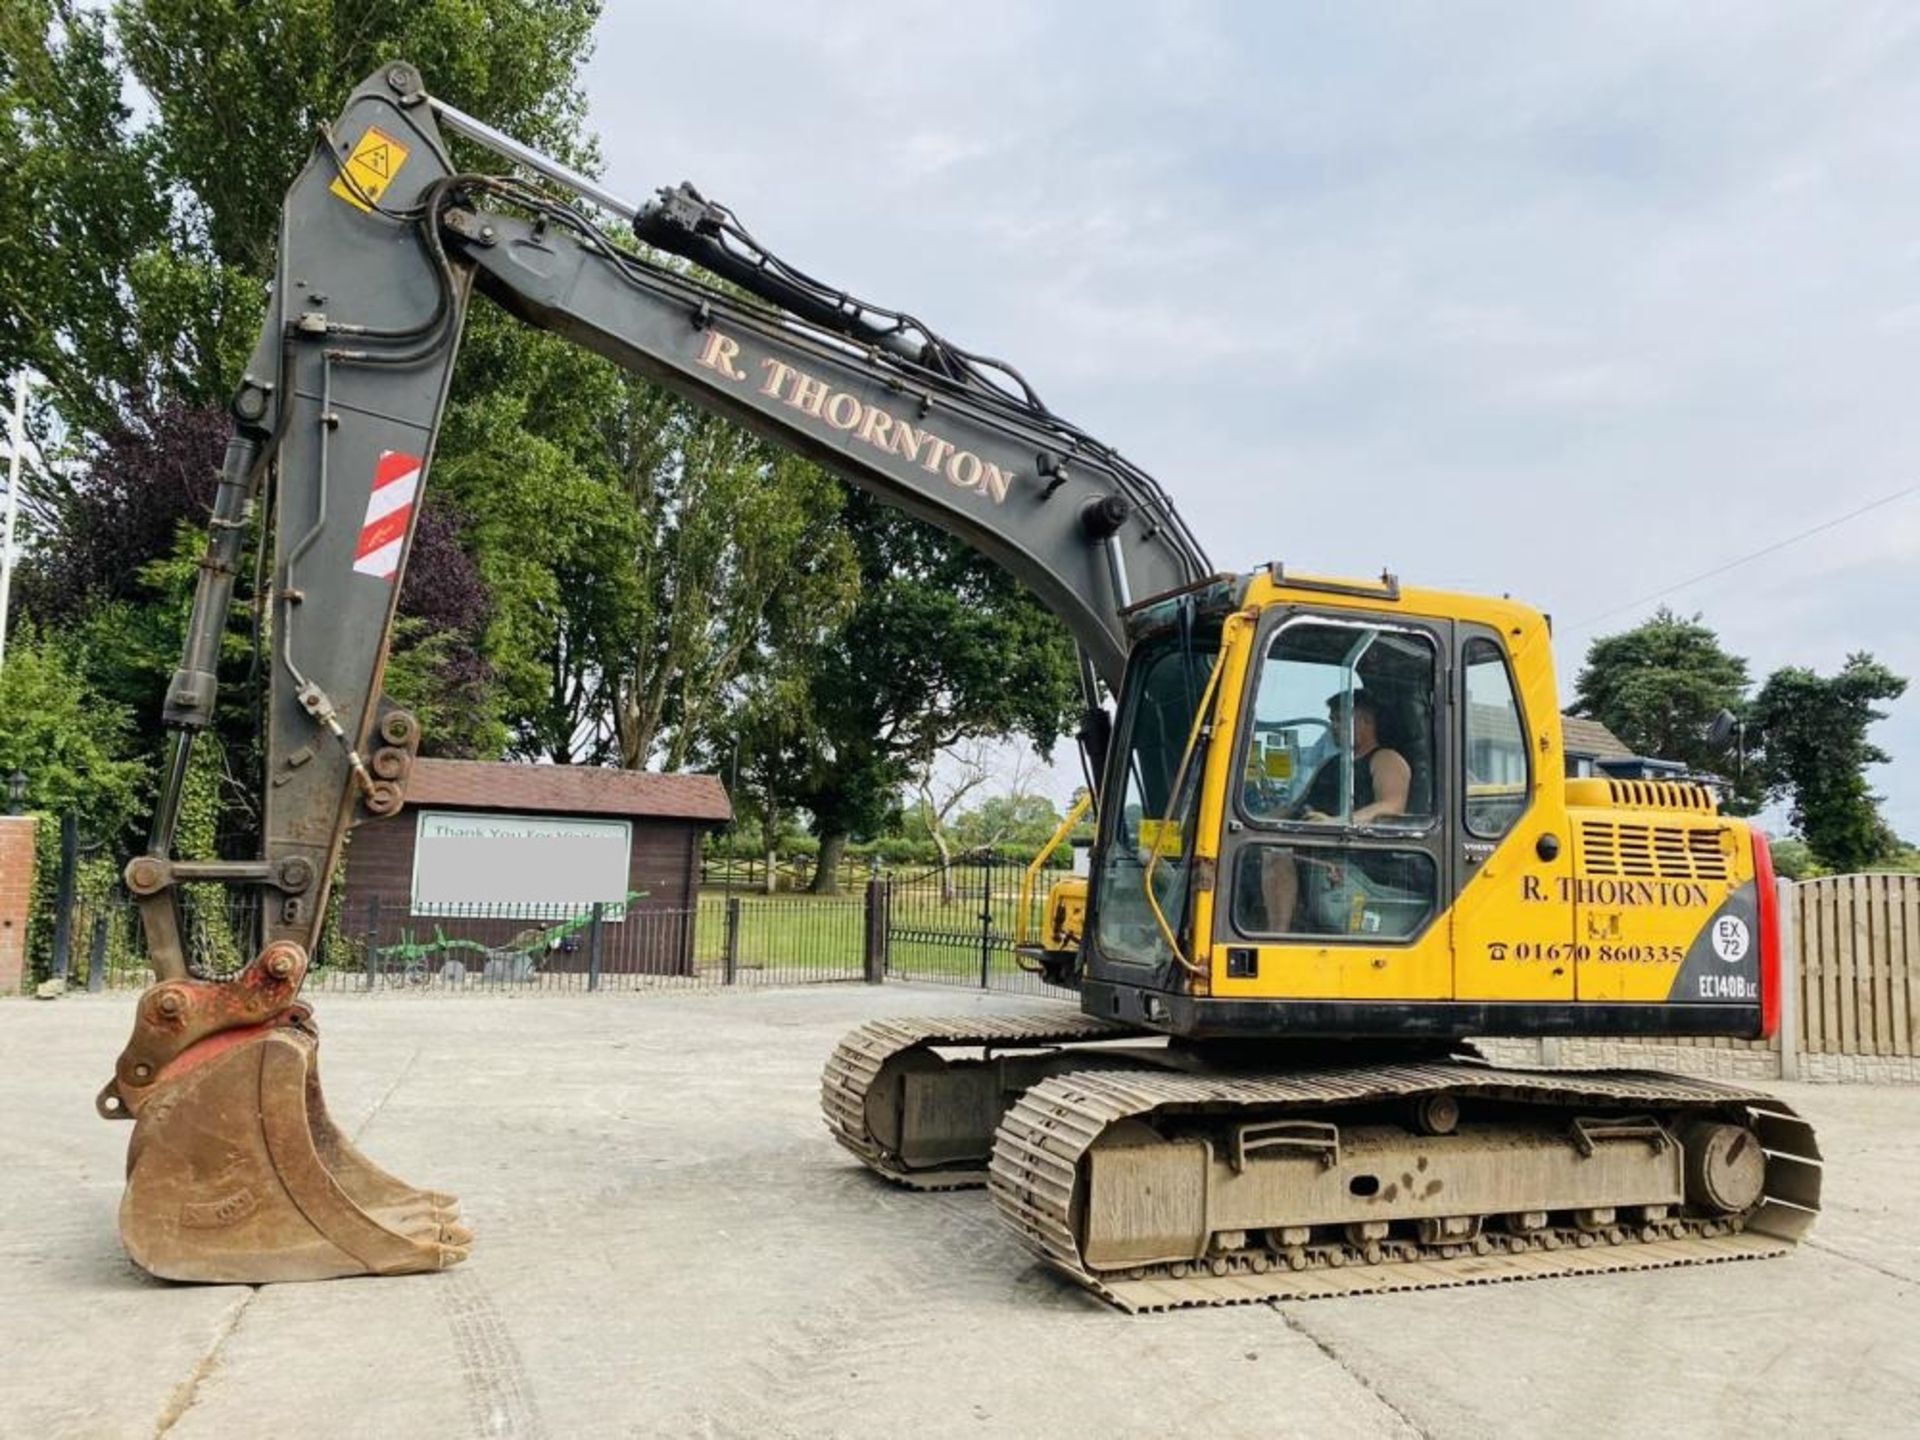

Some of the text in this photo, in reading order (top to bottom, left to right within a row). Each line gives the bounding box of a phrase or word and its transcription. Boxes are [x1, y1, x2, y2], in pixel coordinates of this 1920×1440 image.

[697, 330, 1015, 504] R. THORNTON
[1522, 875, 1709, 907] R. THORNTON
[1719, 921, 1741, 938] EX
[1515, 942, 1684, 963] 01670 860335
[1721, 939, 1741, 956] 72
[1699, 975, 1746, 997] EC140B
